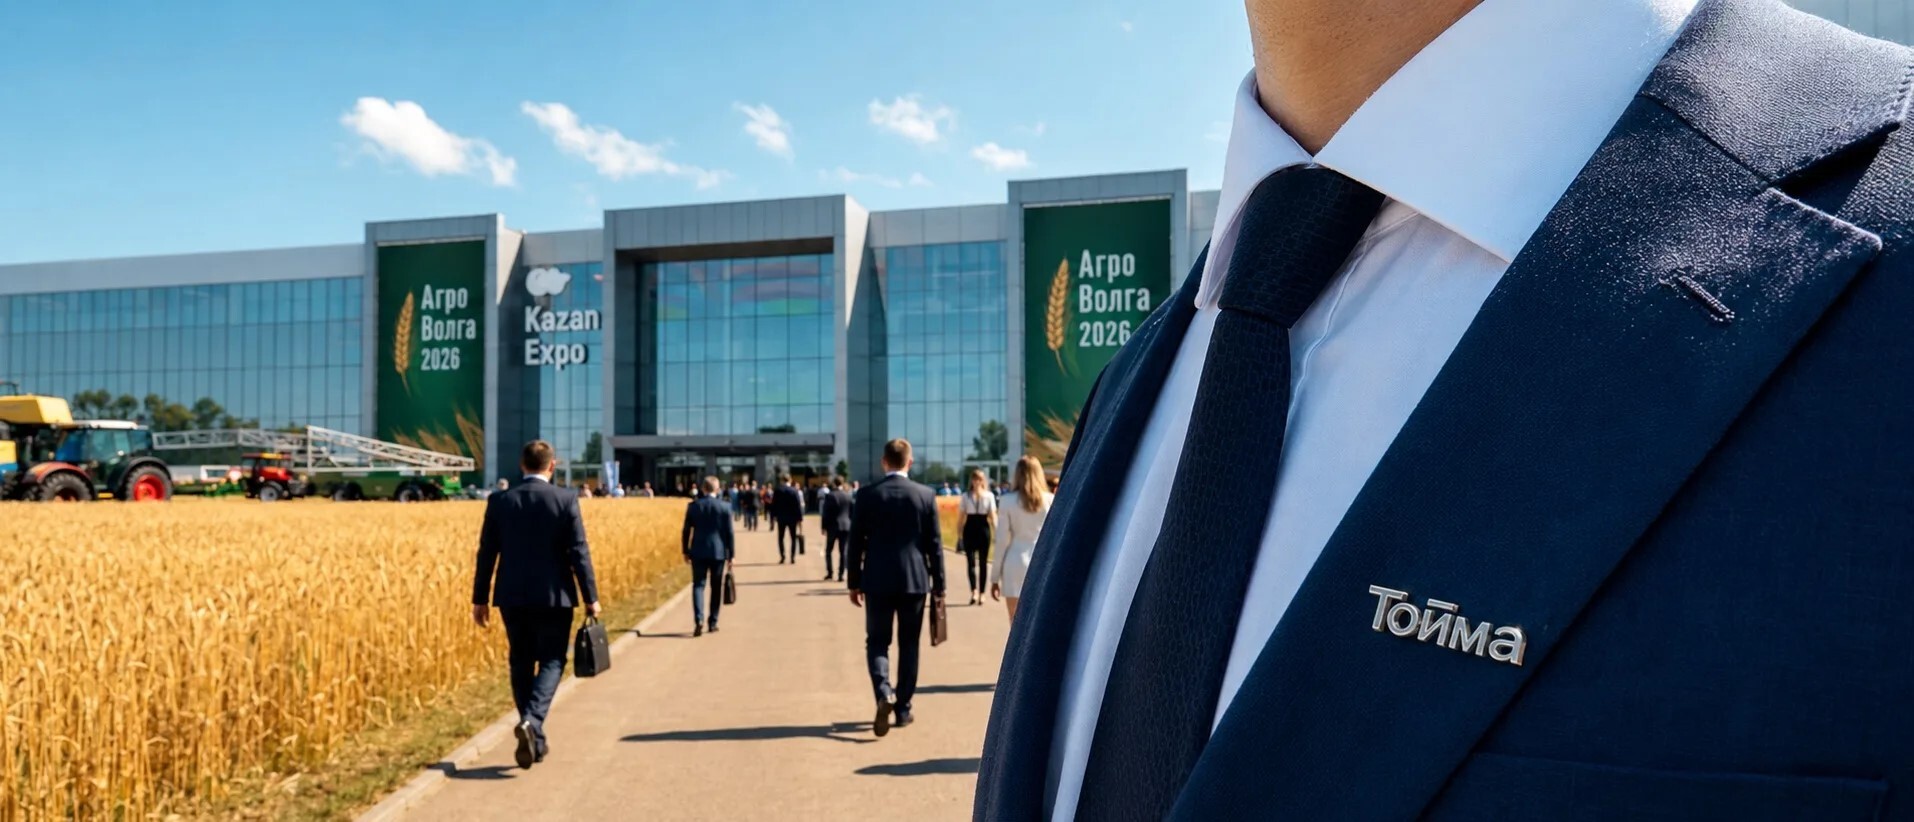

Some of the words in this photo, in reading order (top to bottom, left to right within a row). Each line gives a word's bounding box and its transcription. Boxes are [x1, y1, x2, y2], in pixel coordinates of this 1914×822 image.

[1079, 249, 1135, 283] Агро
[421, 284, 468, 315] Агро
[1079, 284, 1150, 313] Волга
[421, 315, 476, 341] Волга
[525, 305, 600, 333] Kazan
[1079, 320, 1131, 347] 2026
[421, 347, 460, 370] 2026
[525, 339, 586, 371] Expo
[1369, 584, 1527, 666] Тойма
